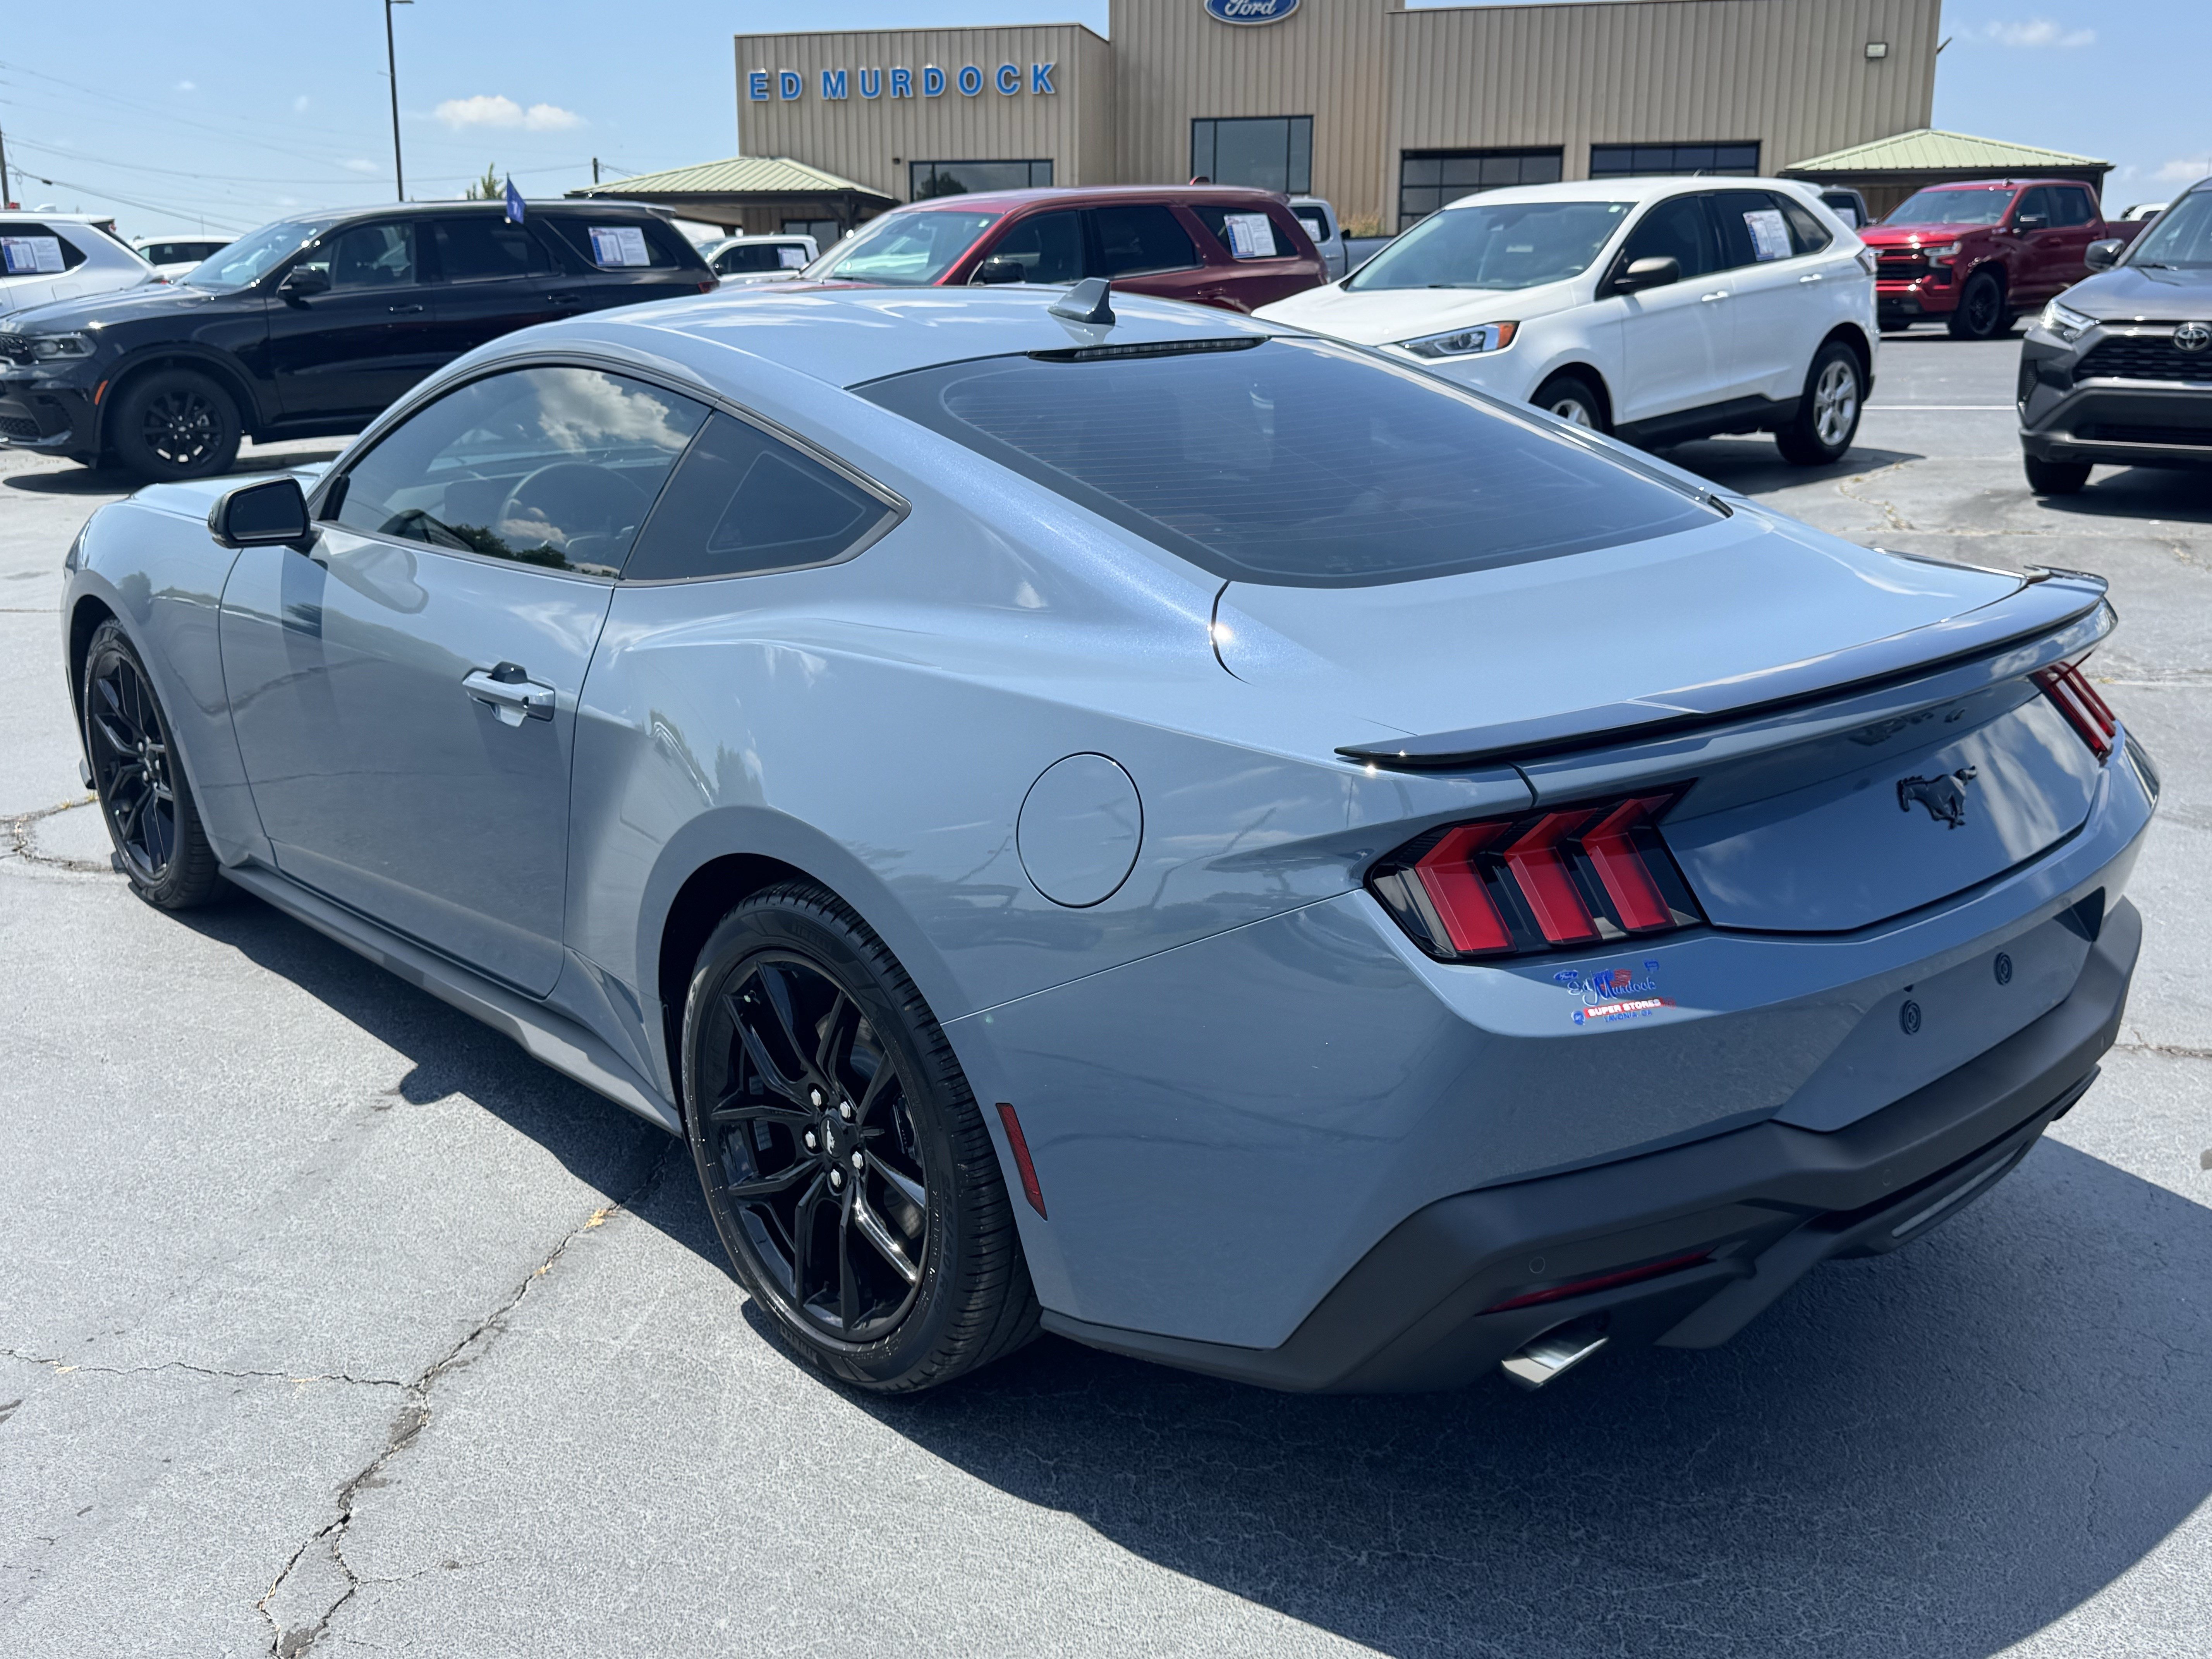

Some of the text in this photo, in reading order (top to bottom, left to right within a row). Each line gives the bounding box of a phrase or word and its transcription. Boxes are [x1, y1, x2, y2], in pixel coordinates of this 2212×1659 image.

[749, 63, 1055, 101] ED MURDOCK
[1567, 978, 1594, 995] Ed
[1582, 970, 1657, 1007] Murdock
[1587, 1004, 1622, 1017] SUPER
[1622, 999, 1662, 1012] STORES
